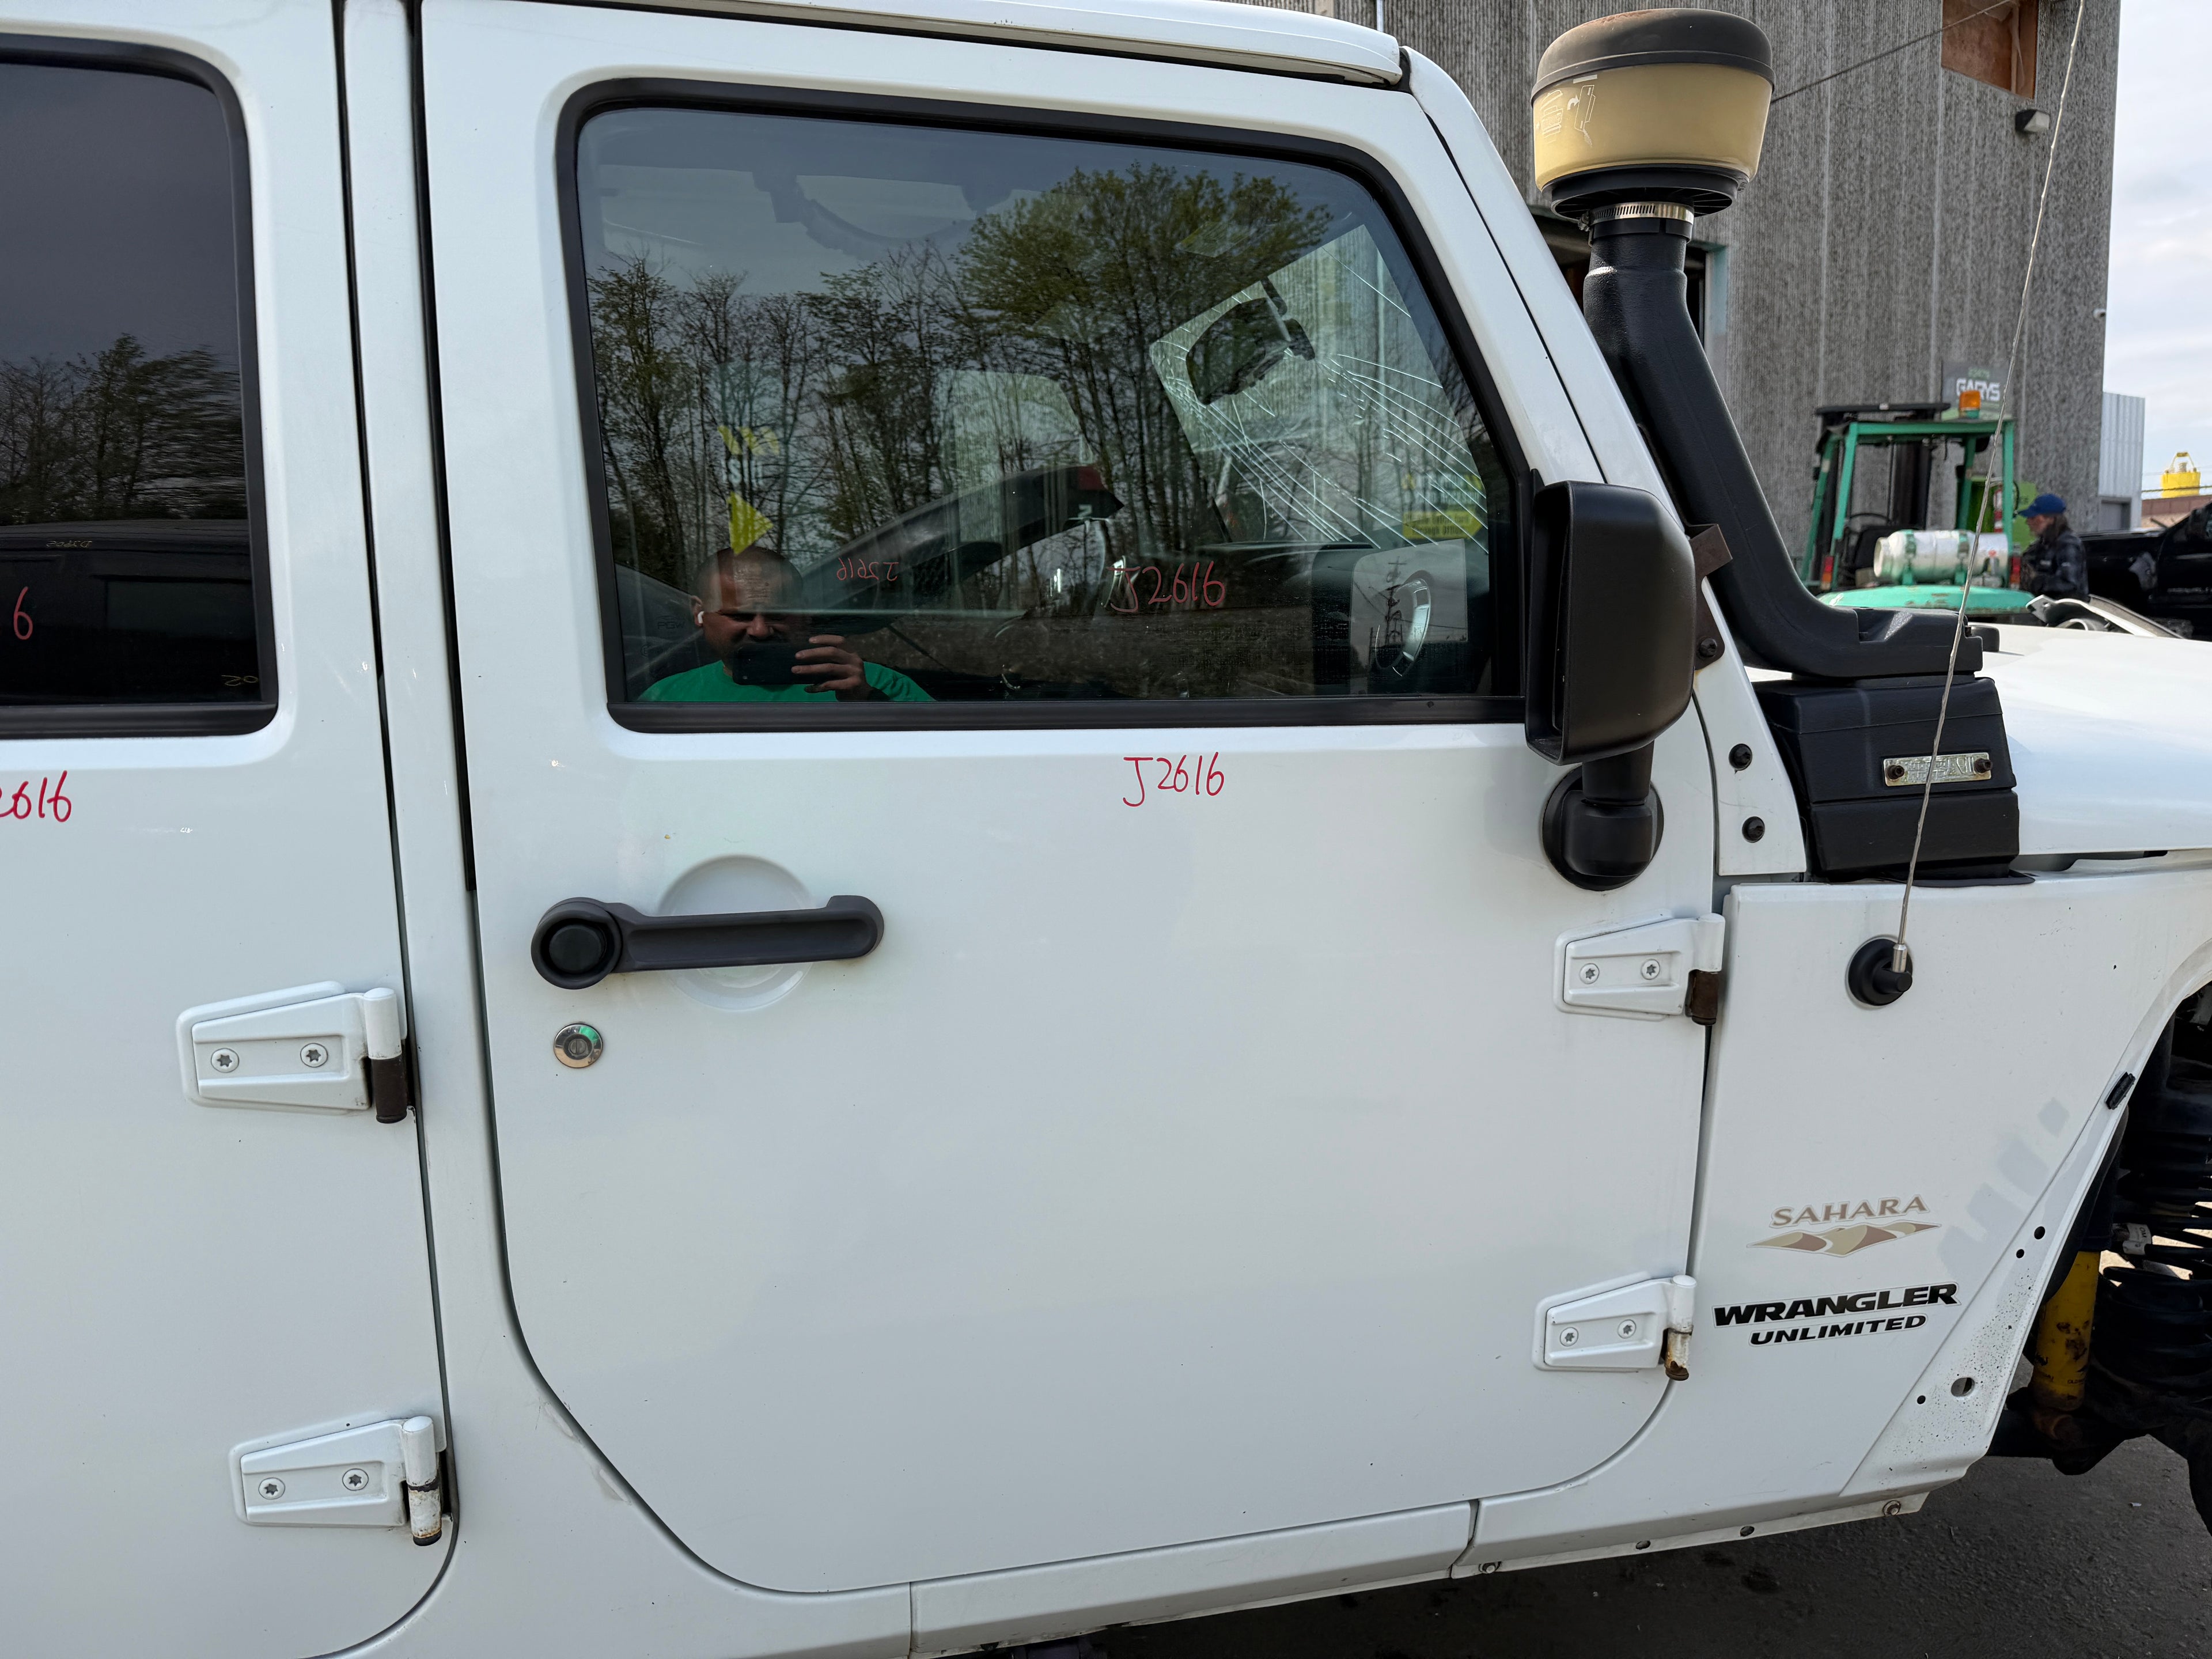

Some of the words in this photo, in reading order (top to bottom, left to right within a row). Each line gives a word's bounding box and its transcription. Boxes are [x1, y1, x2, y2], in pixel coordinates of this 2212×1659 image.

[1106, 560, 1226, 613] J2616
[1122, 751, 1226, 808] J2616
[1771, 1195, 1928, 1226] SAHARA
[1713, 1283, 1958, 1327] WRANGLER
[1750, 1315, 1927, 1345] UNLIMITED
